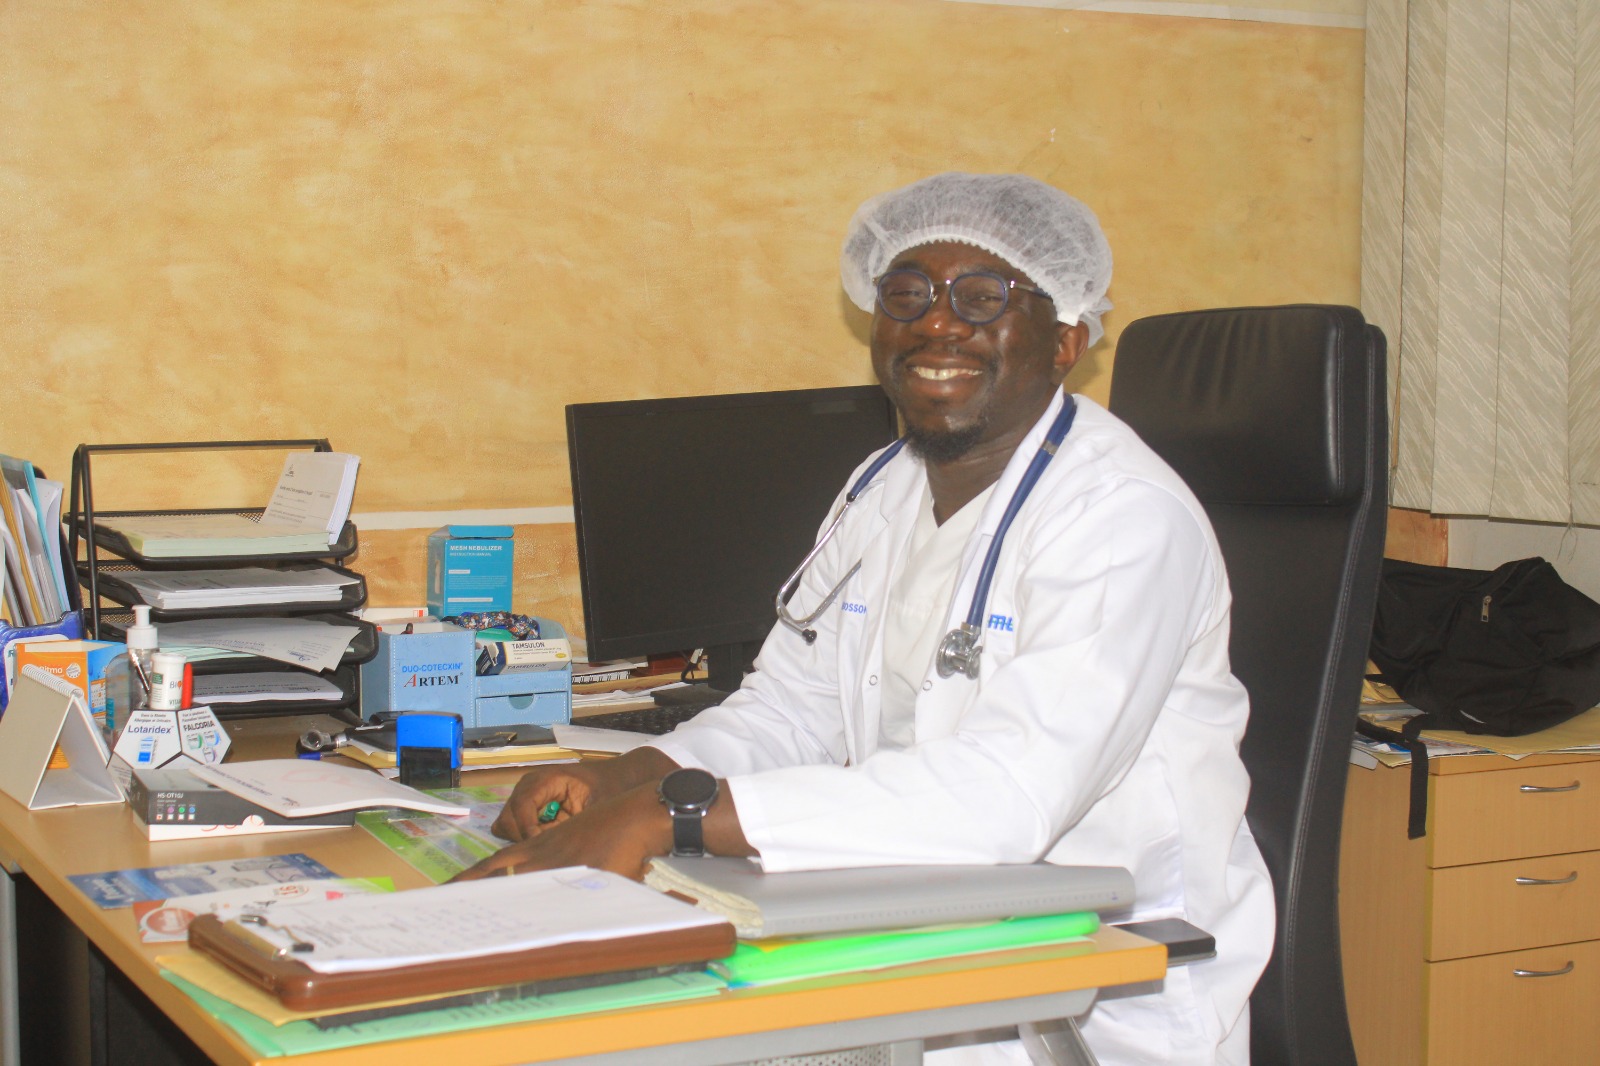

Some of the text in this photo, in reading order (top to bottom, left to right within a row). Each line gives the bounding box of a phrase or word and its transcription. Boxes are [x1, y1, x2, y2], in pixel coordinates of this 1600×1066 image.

[511, 641, 545, 650] TAMSULON
[128, 725, 172, 734] Lotaridex
[183, 720, 216, 732] FALCORIA
